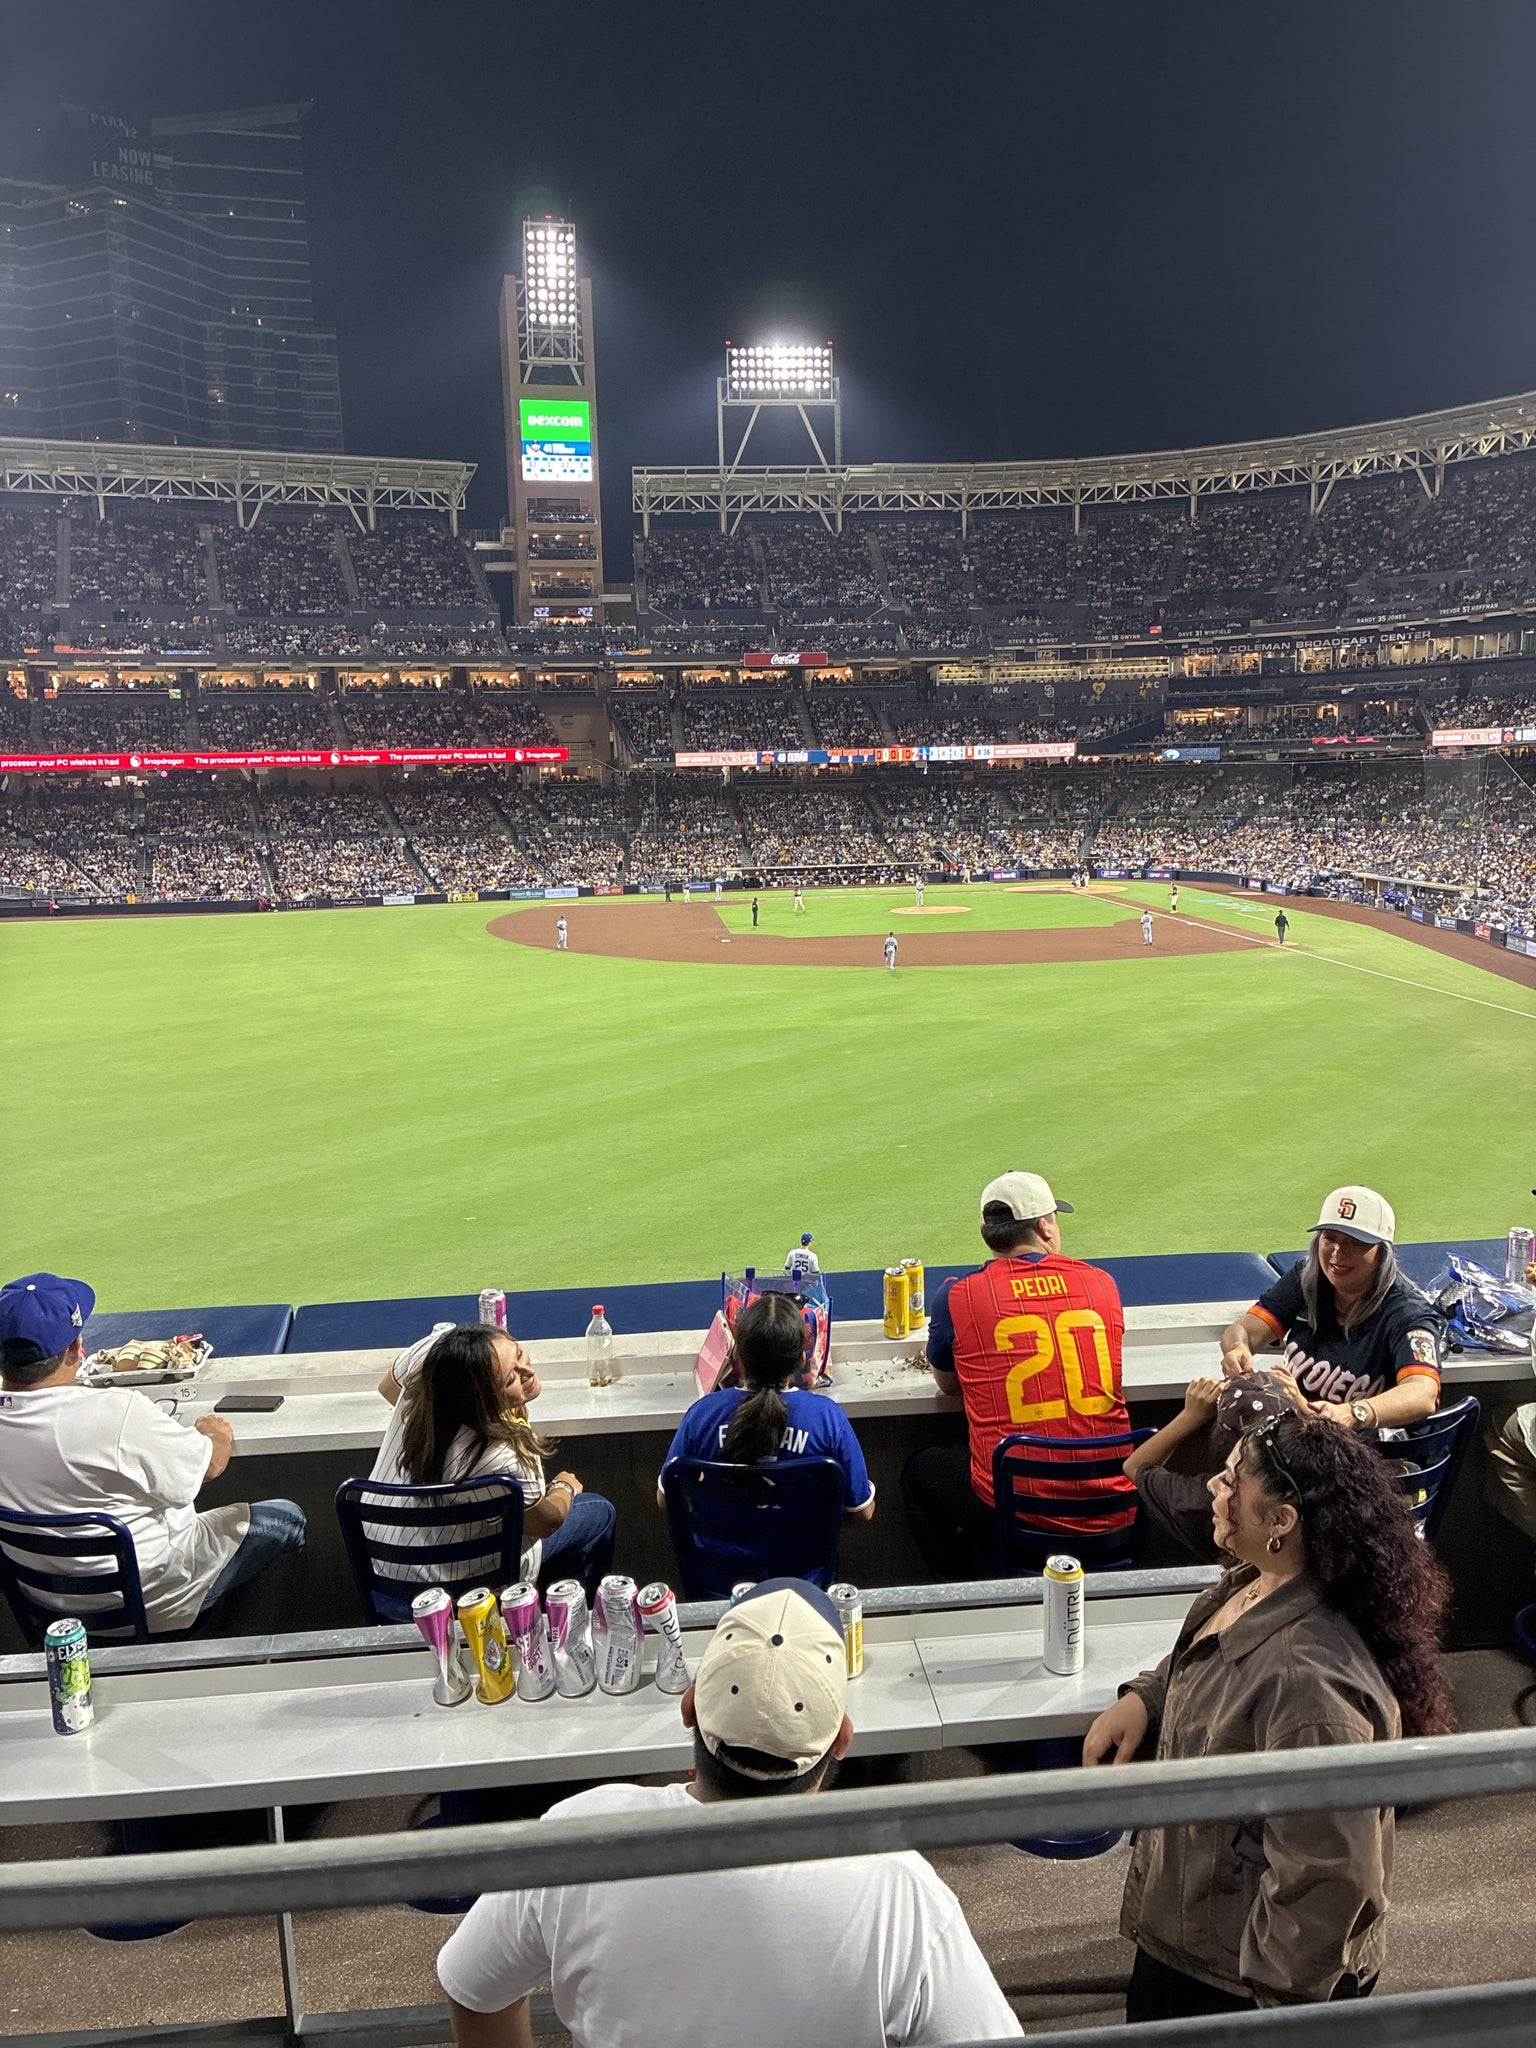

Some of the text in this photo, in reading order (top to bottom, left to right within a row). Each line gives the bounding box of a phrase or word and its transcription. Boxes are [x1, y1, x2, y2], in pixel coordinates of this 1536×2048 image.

[118, 147, 152, 167] NOW
[92, 160, 153, 186] LEASING
[527, 415, 583, 427] Dexcom
[1439, 603, 1499, 615] TREVOR 51 HOFFMAN
[1377, 615, 1387, 623] 35
[1387, 613, 1407, 621] JONES
[1183, 630, 1431, 656] JERRY COLEMAN BROADCAST CENTER
[770, 653, 801, 665] Coca-Cola
[992, 686, 1010, 694] RAK
[143, 757, 185, 766] Snapdragon
[209, 757, 246, 765] processor
[342, 755, 380, 763] Snapdragon
[403, 753, 437, 761] processor
[0, 760, 38, 768] processor
[39, 760, 55, 768] your
[1337, 1197, 1358, 1221] SD
[795, 1260, 809, 1273] 25
[1010, 1275, 1068, 1299] PEDRI
[994, 1309, 1115, 1424] 20
[180, 1388, 190, 1398] 15
